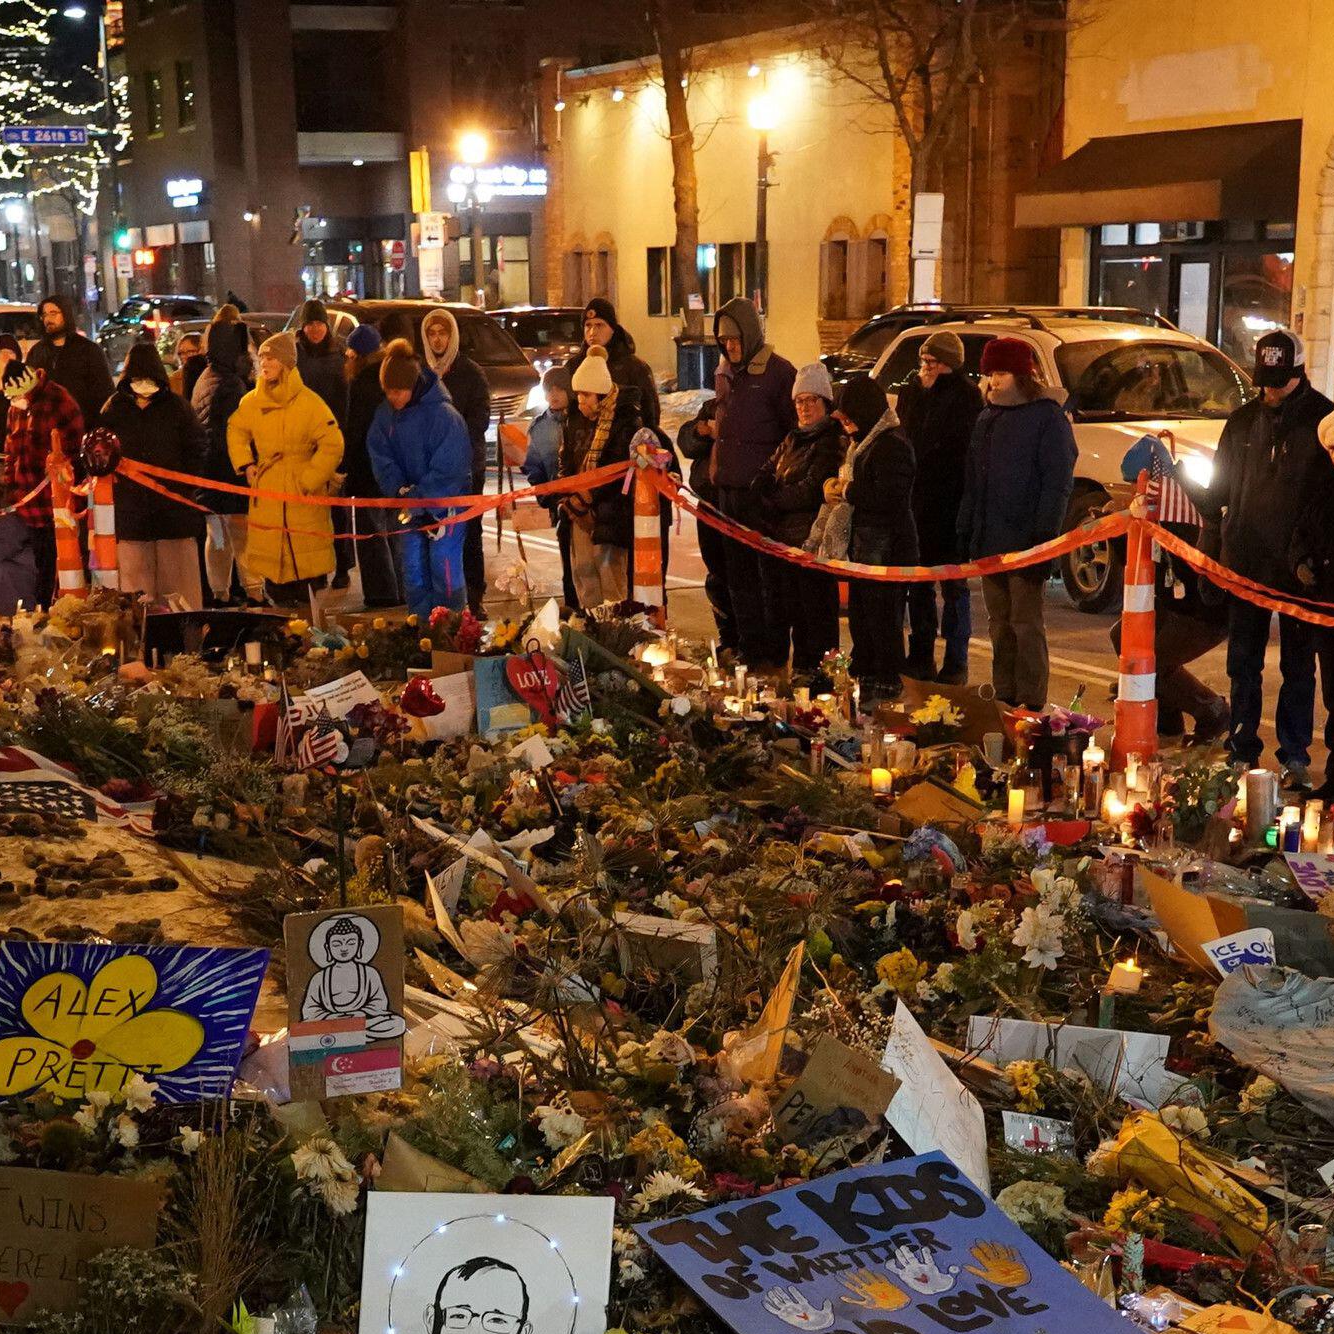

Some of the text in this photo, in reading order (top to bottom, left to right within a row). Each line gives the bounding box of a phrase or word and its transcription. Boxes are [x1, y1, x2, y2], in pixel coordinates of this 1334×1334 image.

[21, 129, 84, 142] E 26th St
[516, 669, 551, 689] LOVE
[1211, 941, 1240, 958] ICE
[33, 982, 148, 1020] ALEX
[647, 1160, 987, 1267] THE KIDS
[700, 1227, 954, 1300] OF WHITTIER
[915, 1285, 1051, 1334] LOVE
